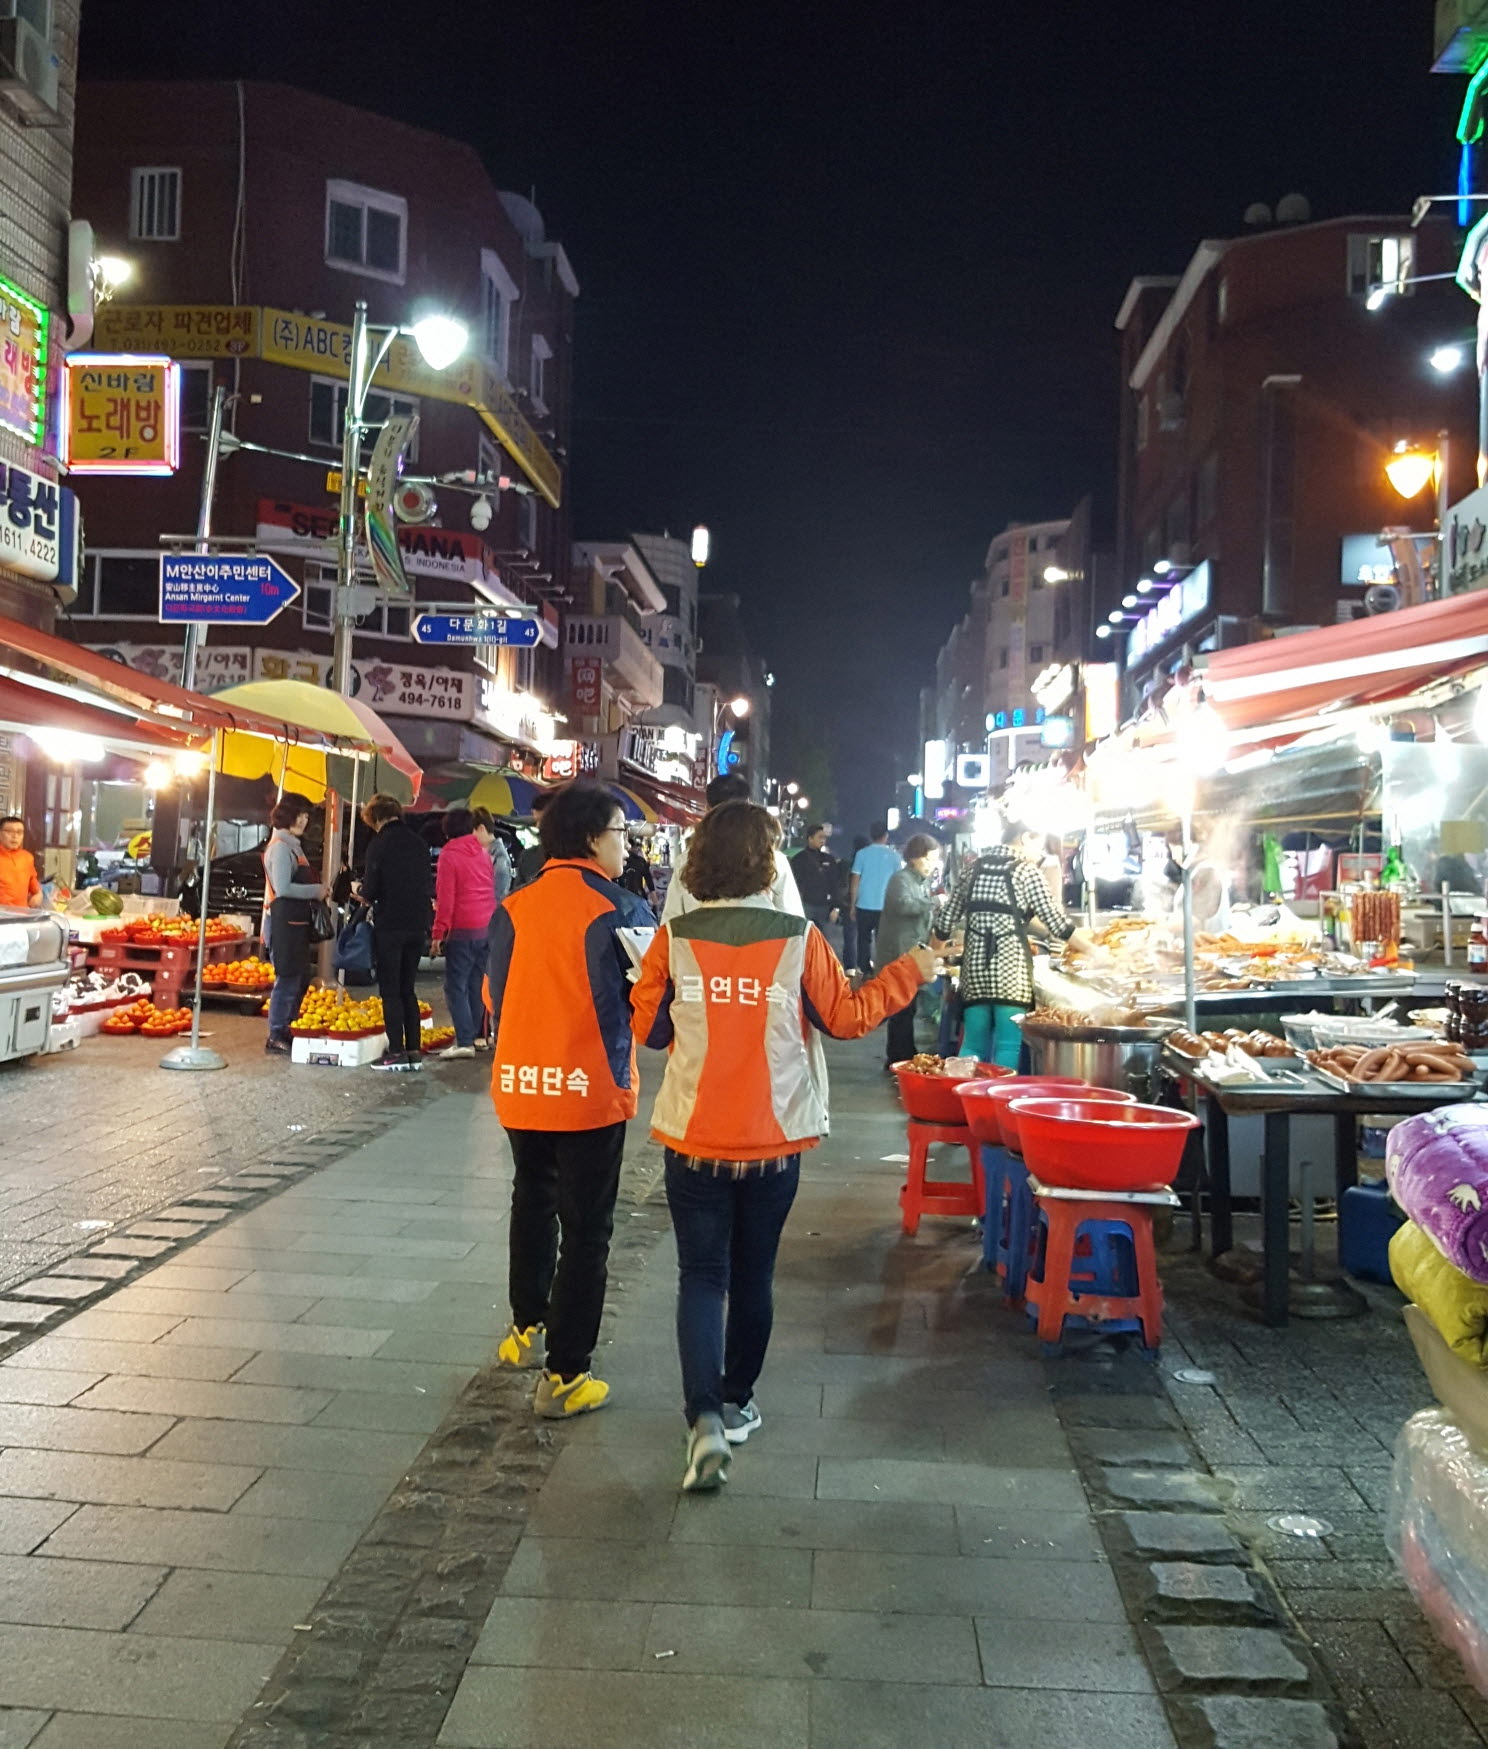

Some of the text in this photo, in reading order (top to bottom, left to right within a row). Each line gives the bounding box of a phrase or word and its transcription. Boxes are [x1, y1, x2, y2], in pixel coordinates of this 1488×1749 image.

[104, 309, 252, 335] 근로자 파견업체
[80, 373, 155, 393] 신바람
[78, 397, 161, 443] 노래방
[165, 564, 271, 581] M안산이주민센터
[416, 557, 466, 573] INDONESIA
[164, 592, 188, 602] Ansan
[225, 593, 250, 603] Center
[261, 582, 279, 596] 10m
[421, 624, 432, 634] 45
[524, 628, 535, 638] 43
[398, 690, 462, 712] 494-7618
[681, 975, 788, 1006] 금연단속
[500, 1064, 589, 1098] 금연단속
